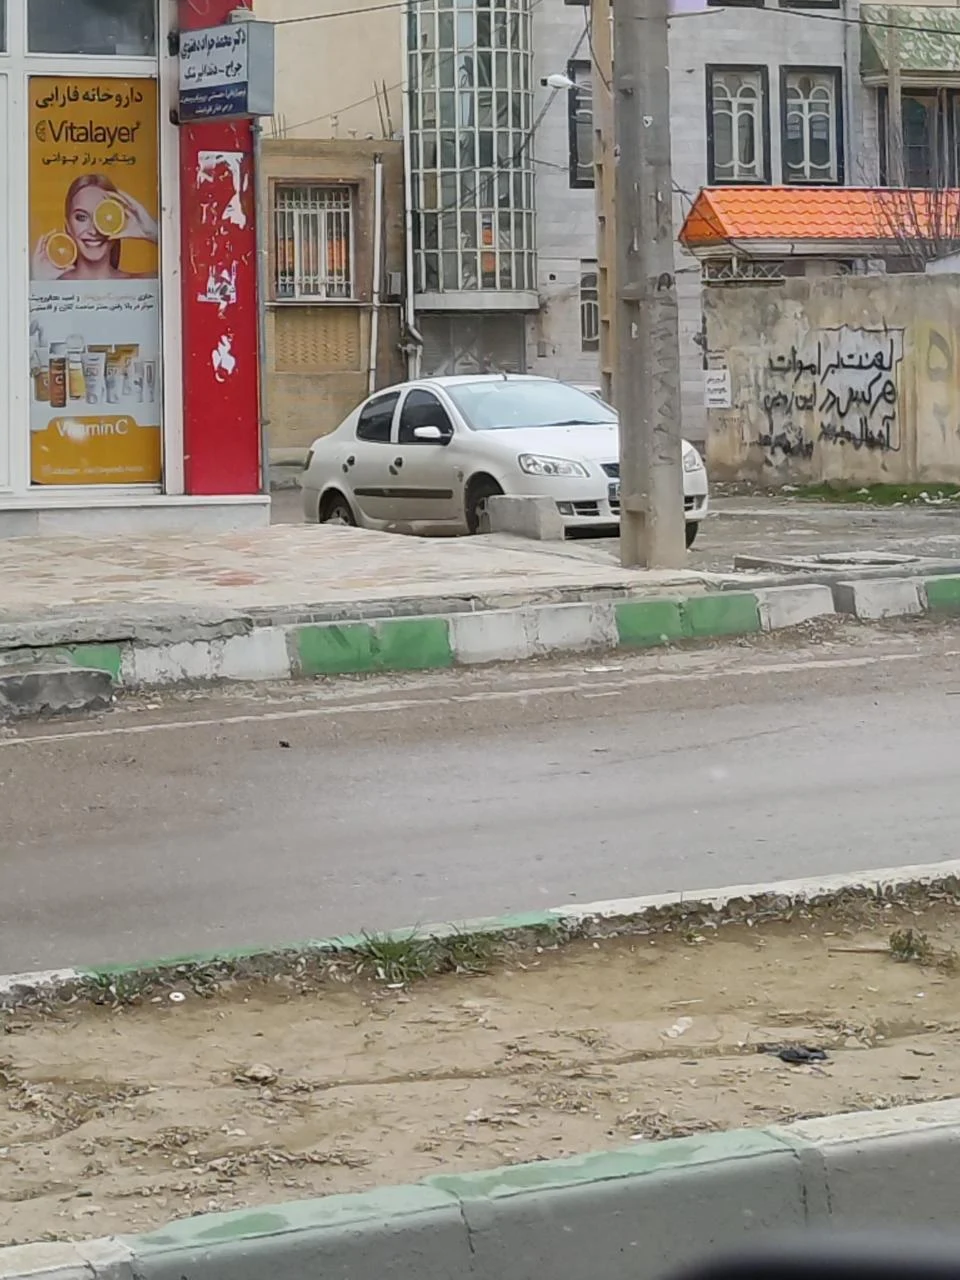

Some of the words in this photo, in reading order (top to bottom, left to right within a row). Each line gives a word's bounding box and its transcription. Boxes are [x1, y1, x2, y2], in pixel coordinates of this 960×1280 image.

[35, 85, 80, 109] فارابی
[82, 86, 143, 108] داروخانه
[48, 120, 138, 148] Vitalayer
[41, 151, 79, 166] جوانی
[769, 340, 821, 384] اموات
[820, 350, 841, 385] بر
[840, 339, 893, 372] لعنت
